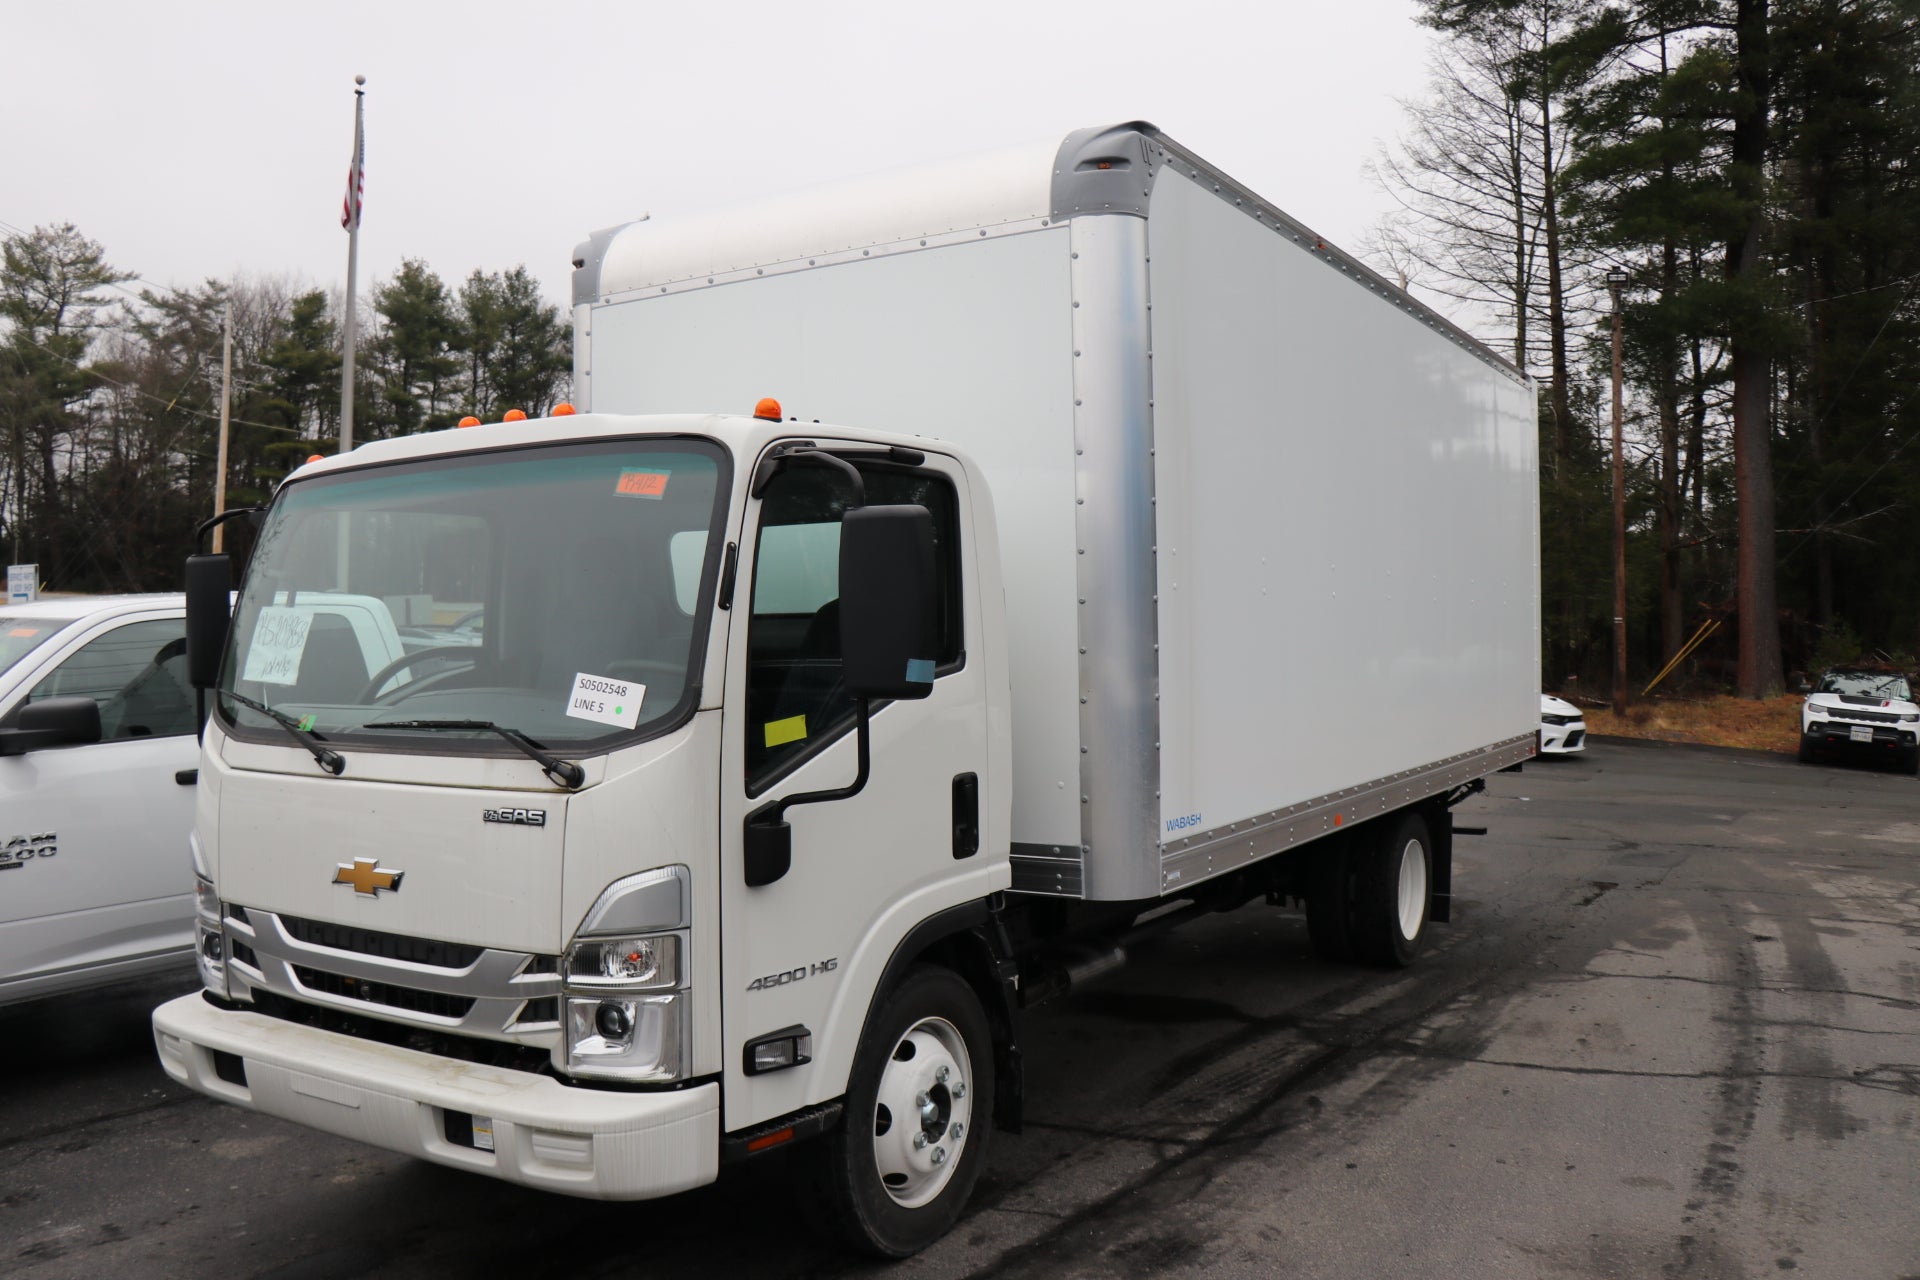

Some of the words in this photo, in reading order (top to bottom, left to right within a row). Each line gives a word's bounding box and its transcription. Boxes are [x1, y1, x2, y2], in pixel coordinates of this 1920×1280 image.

[579, 679, 628, 697] S0502548
[574, 697, 597, 712] LINE
[597, 702, 605, 713] 5
[498, 808, 545, 825] GAS
[1166, 812, 1202, 832] WABASH
[0, 831, 57, 849] AM
[746, 966, 807, 992] 4500
[810, 957, 838, 977] HG
